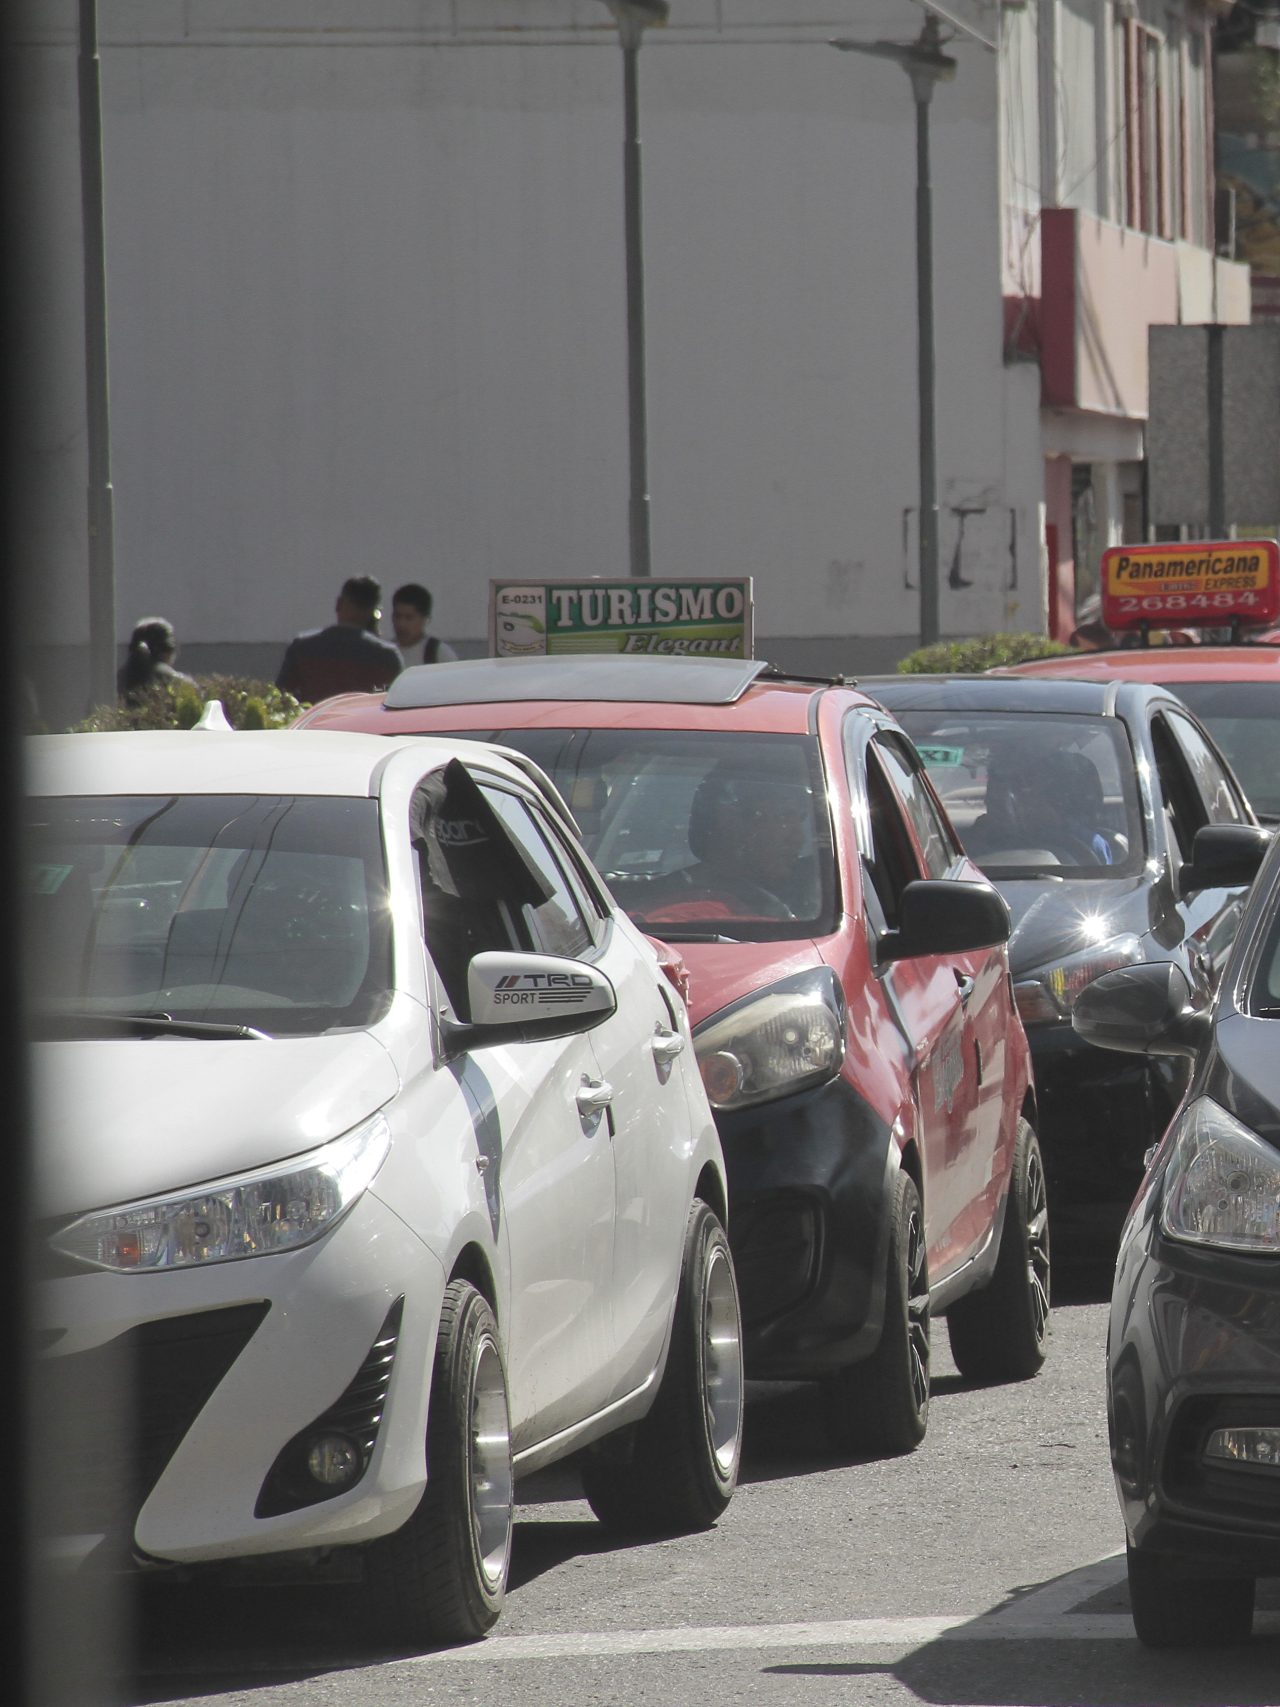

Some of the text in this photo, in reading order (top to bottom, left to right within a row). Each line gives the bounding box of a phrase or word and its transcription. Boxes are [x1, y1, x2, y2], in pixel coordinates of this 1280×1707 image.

[1115, 553, 1260, 580] Panamericana
[1203, 576, 1257, 590] EXPRESS
[501, 594, 543, 605] E-0231
[551, 586, 744, 627] TURISMO
[1119, 592, 1259, 612] 268484
[622, 633, 743, 656] Elegant
[524, 974, 593, 987] TRD
[494, 992, 537, 1004] SPORT
